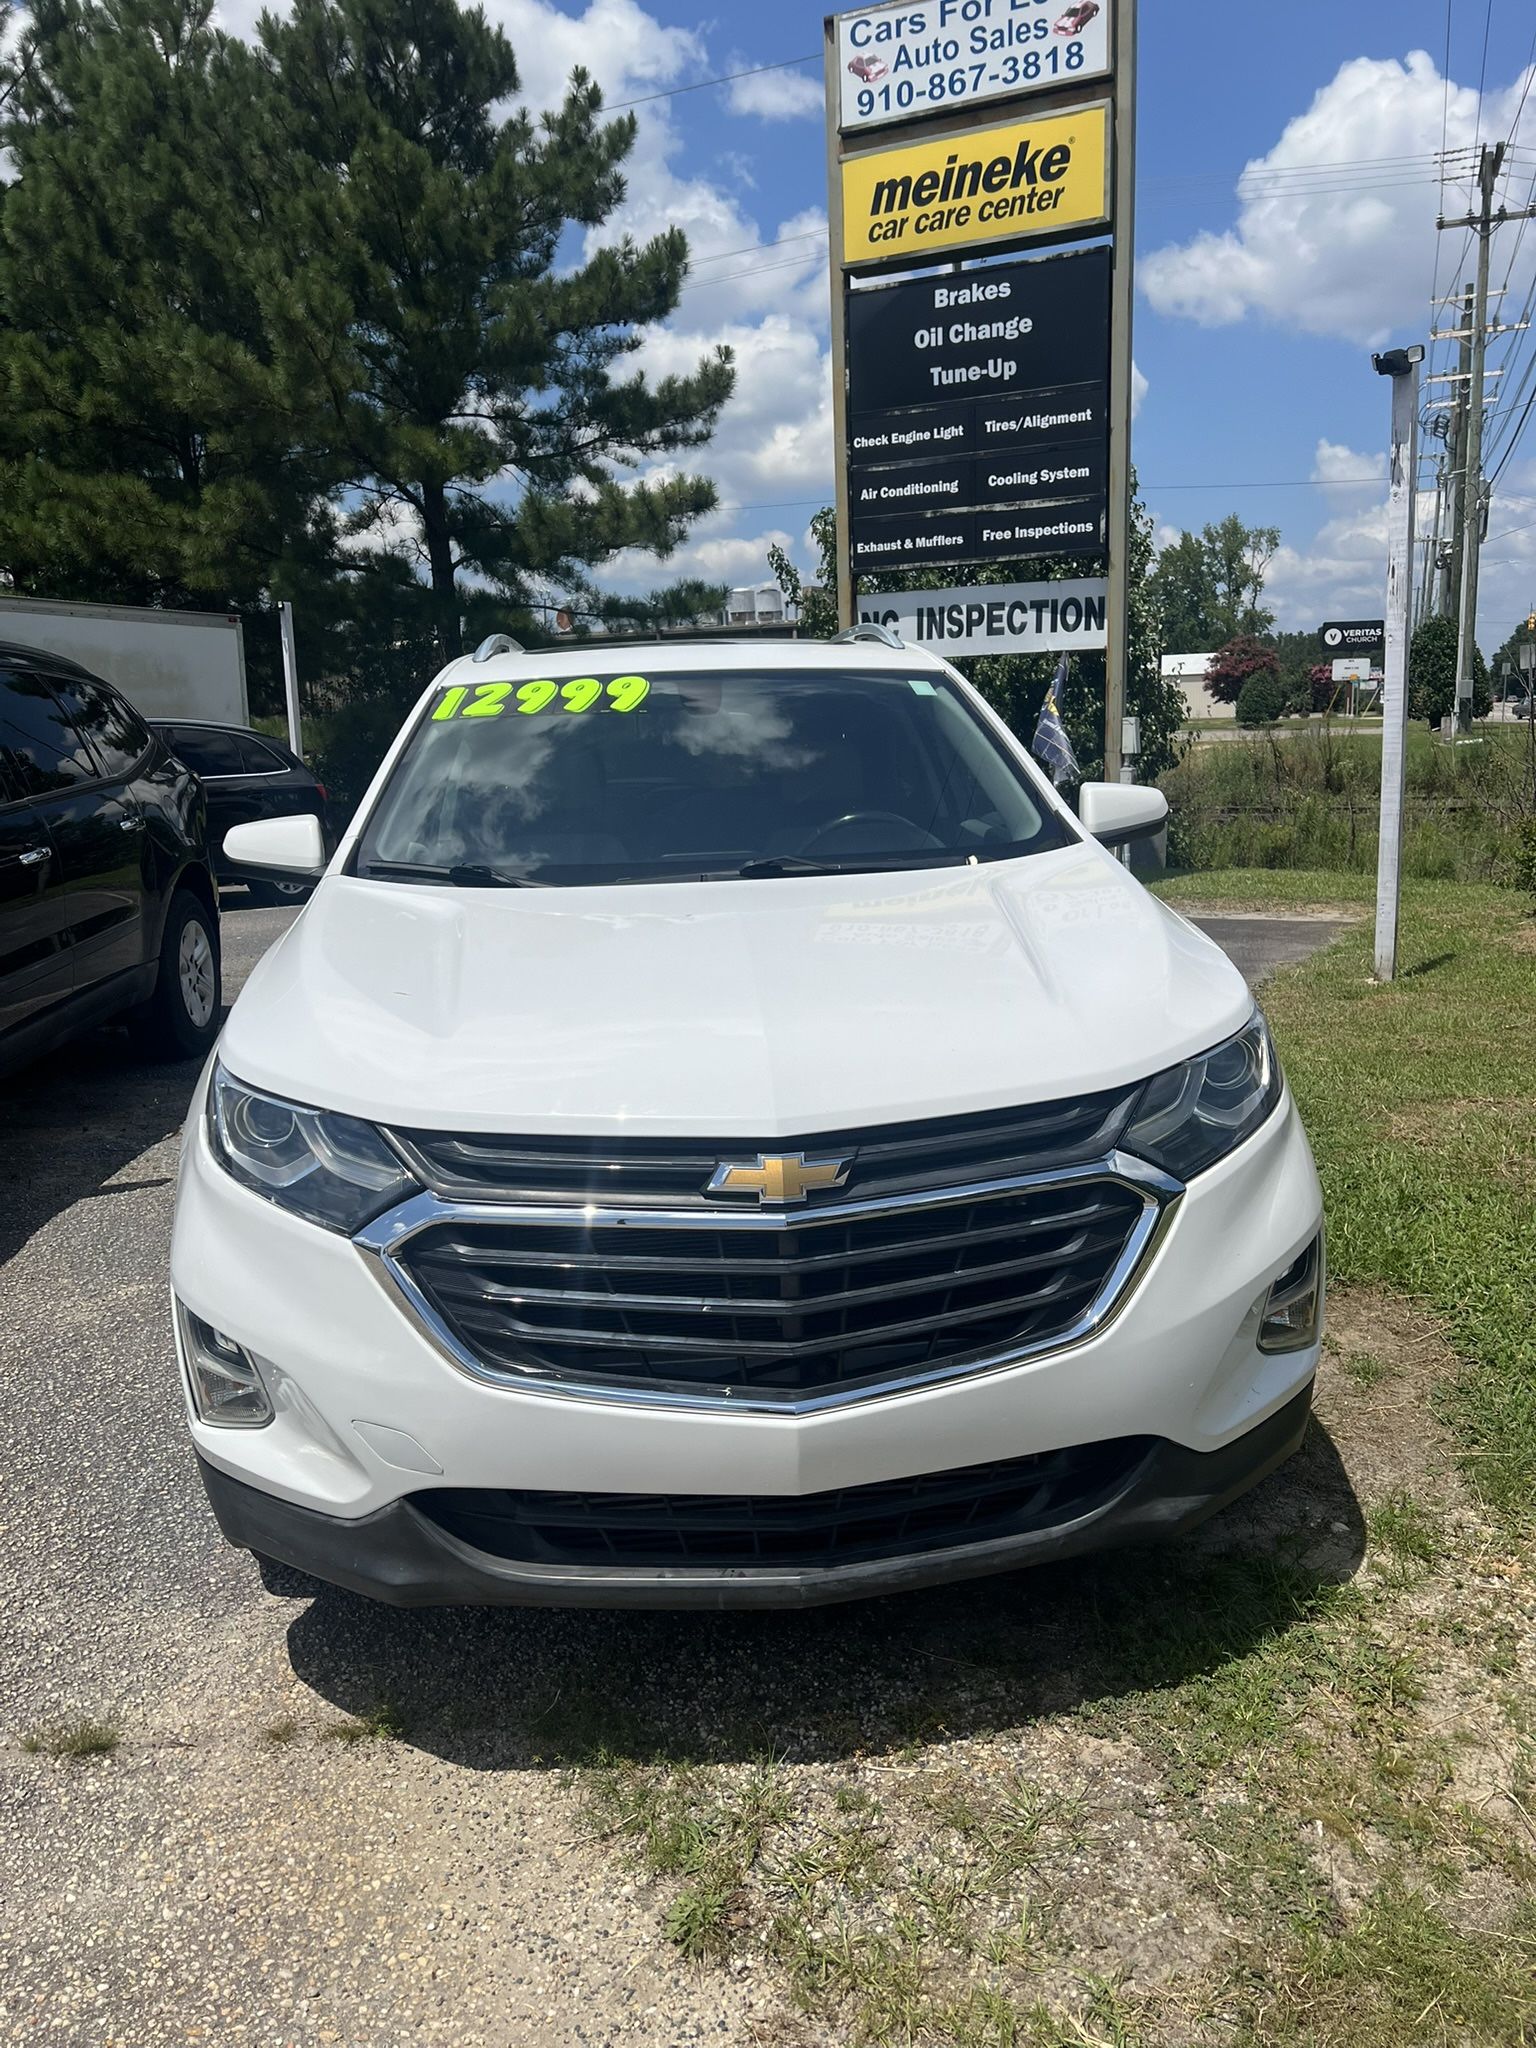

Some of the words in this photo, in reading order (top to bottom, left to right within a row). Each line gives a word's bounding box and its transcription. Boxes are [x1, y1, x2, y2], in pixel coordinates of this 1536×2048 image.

[850, 12, 926, 48] Cars
[939, 0, 993, 28] For
[893, 37, 960, 74] Auto
[970, 17, 1049, 55] Sales
[857, 41, 1084, 117] 910-867-3818
[870, 140, 1072, 216] meineke
[868, 219, 909, 243] car
[914, 205, 971, 235] care
[978, 186, 1065, 223] center
[934, 281, 1012, 309] Brakes
[914, 328, 943, 349] Oil
[949, 315, 1033, 344] Change
[930, 357, 1017, 386] Tune-Up
[984, 408, 1093, 433] Tires/Alignment
[853, 433, 889, 448] Check
[891, 429, 931, 447] Engine
[933, 424, 964, 442] Light
[860, 488, 878, 501] Air
[880, 478, 959, 499] Conditioning
[988, 471, 1038, 488] Cooling
[1040, 465, 1090, 482] System
[857, 539, 902, 554] Exhaust
[904, 538, 914, 549] &
[915, 533, 964, 549] Mufflers
[983, 527, 1012, 542] Free
[1014, 520, 1093, 540] Inspections
[916, 596, 1106, 641] INSPECTION
[1343, 628, 1382, 637] VERITAS
[432, 675, 651, 721] 12999
